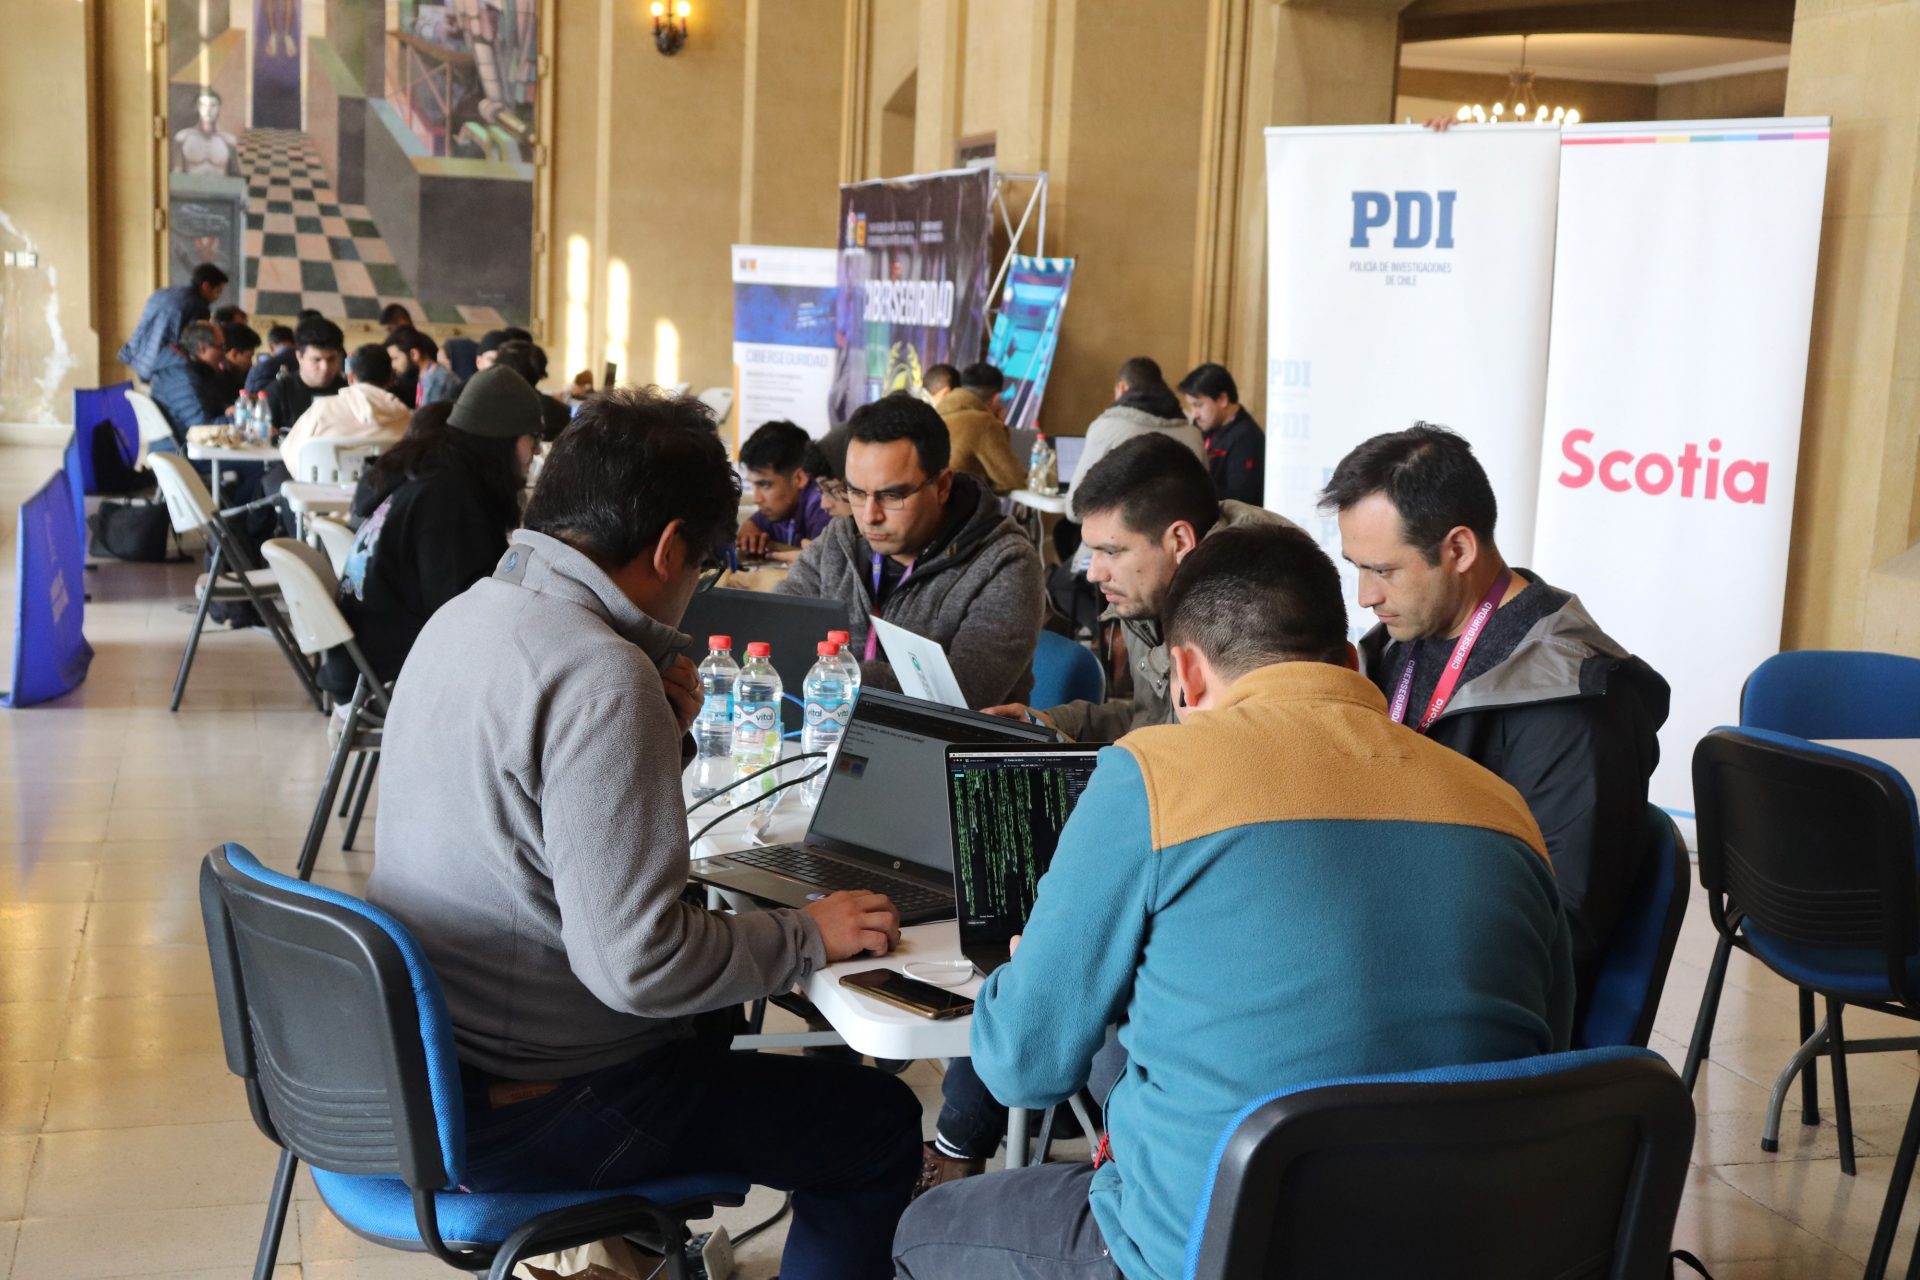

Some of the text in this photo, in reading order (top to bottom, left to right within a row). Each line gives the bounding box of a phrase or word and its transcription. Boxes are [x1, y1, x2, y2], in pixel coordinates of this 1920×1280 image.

[1349, 190, 1457, 249] PDI
[1379, 261, 1390, 272] DE
[1391, 261, 1452, 273] INVESTIGACIONES
[1385, 274, 1417, 286] DE CHILE
[1558, 428, 1769, 504] Scotia
[1451, 601, 1493, 670] CIBERSEGURIDAD
[1391, 660, 1415, 723] CIBERSEGURID
[1421, 697, 1444, 729] Scotia
